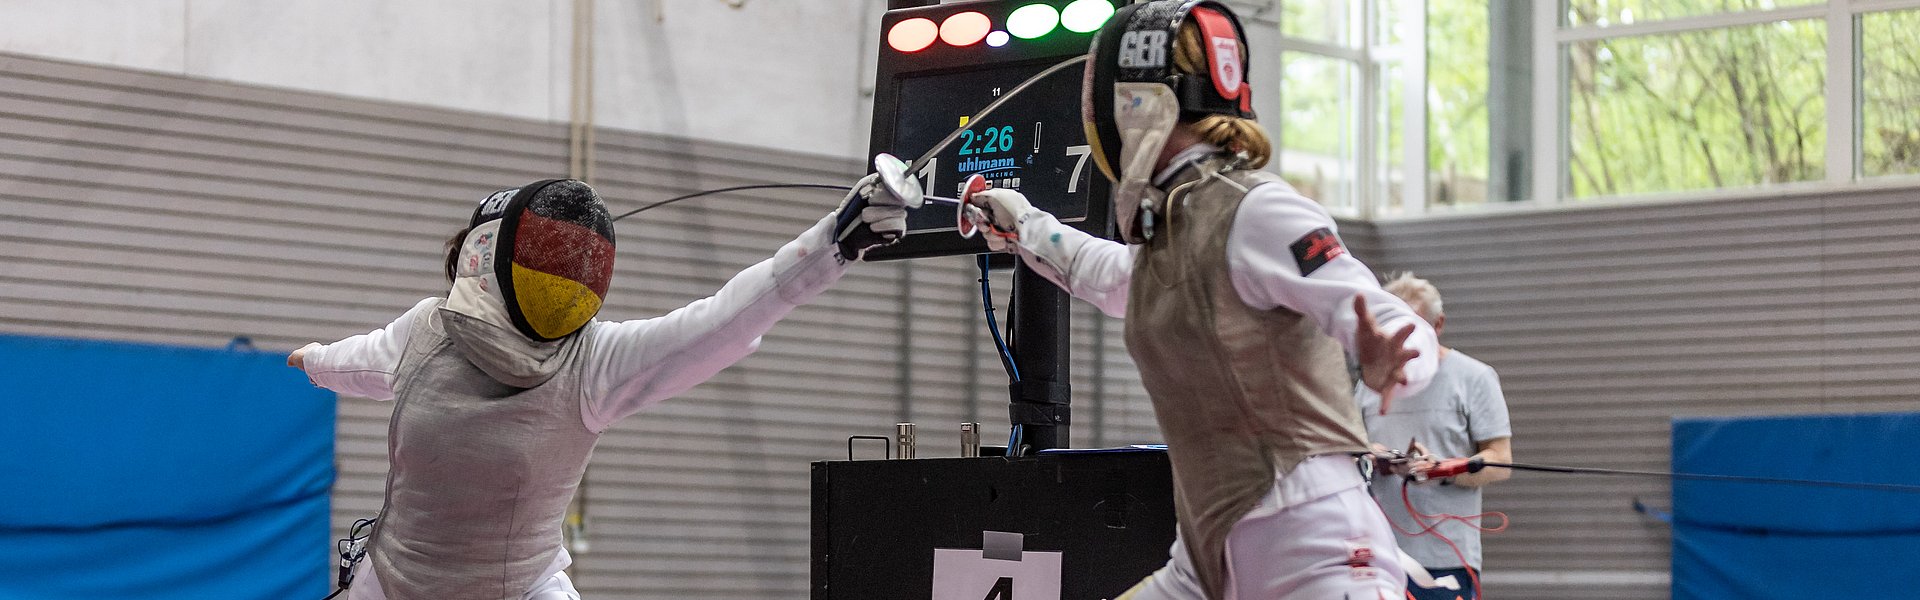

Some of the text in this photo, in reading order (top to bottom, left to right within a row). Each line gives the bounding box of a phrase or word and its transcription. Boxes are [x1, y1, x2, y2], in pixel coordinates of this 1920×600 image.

[1118, 30, 1168, 67] GER
[992, 87, 1001, 97] 11
[959, 126, 1014, 155] 2:26
[958, 157, 1015, 172] uhlmann
[982, 170, 1014, 179] ENCING
[1066, 145, 1092, 193] 7
